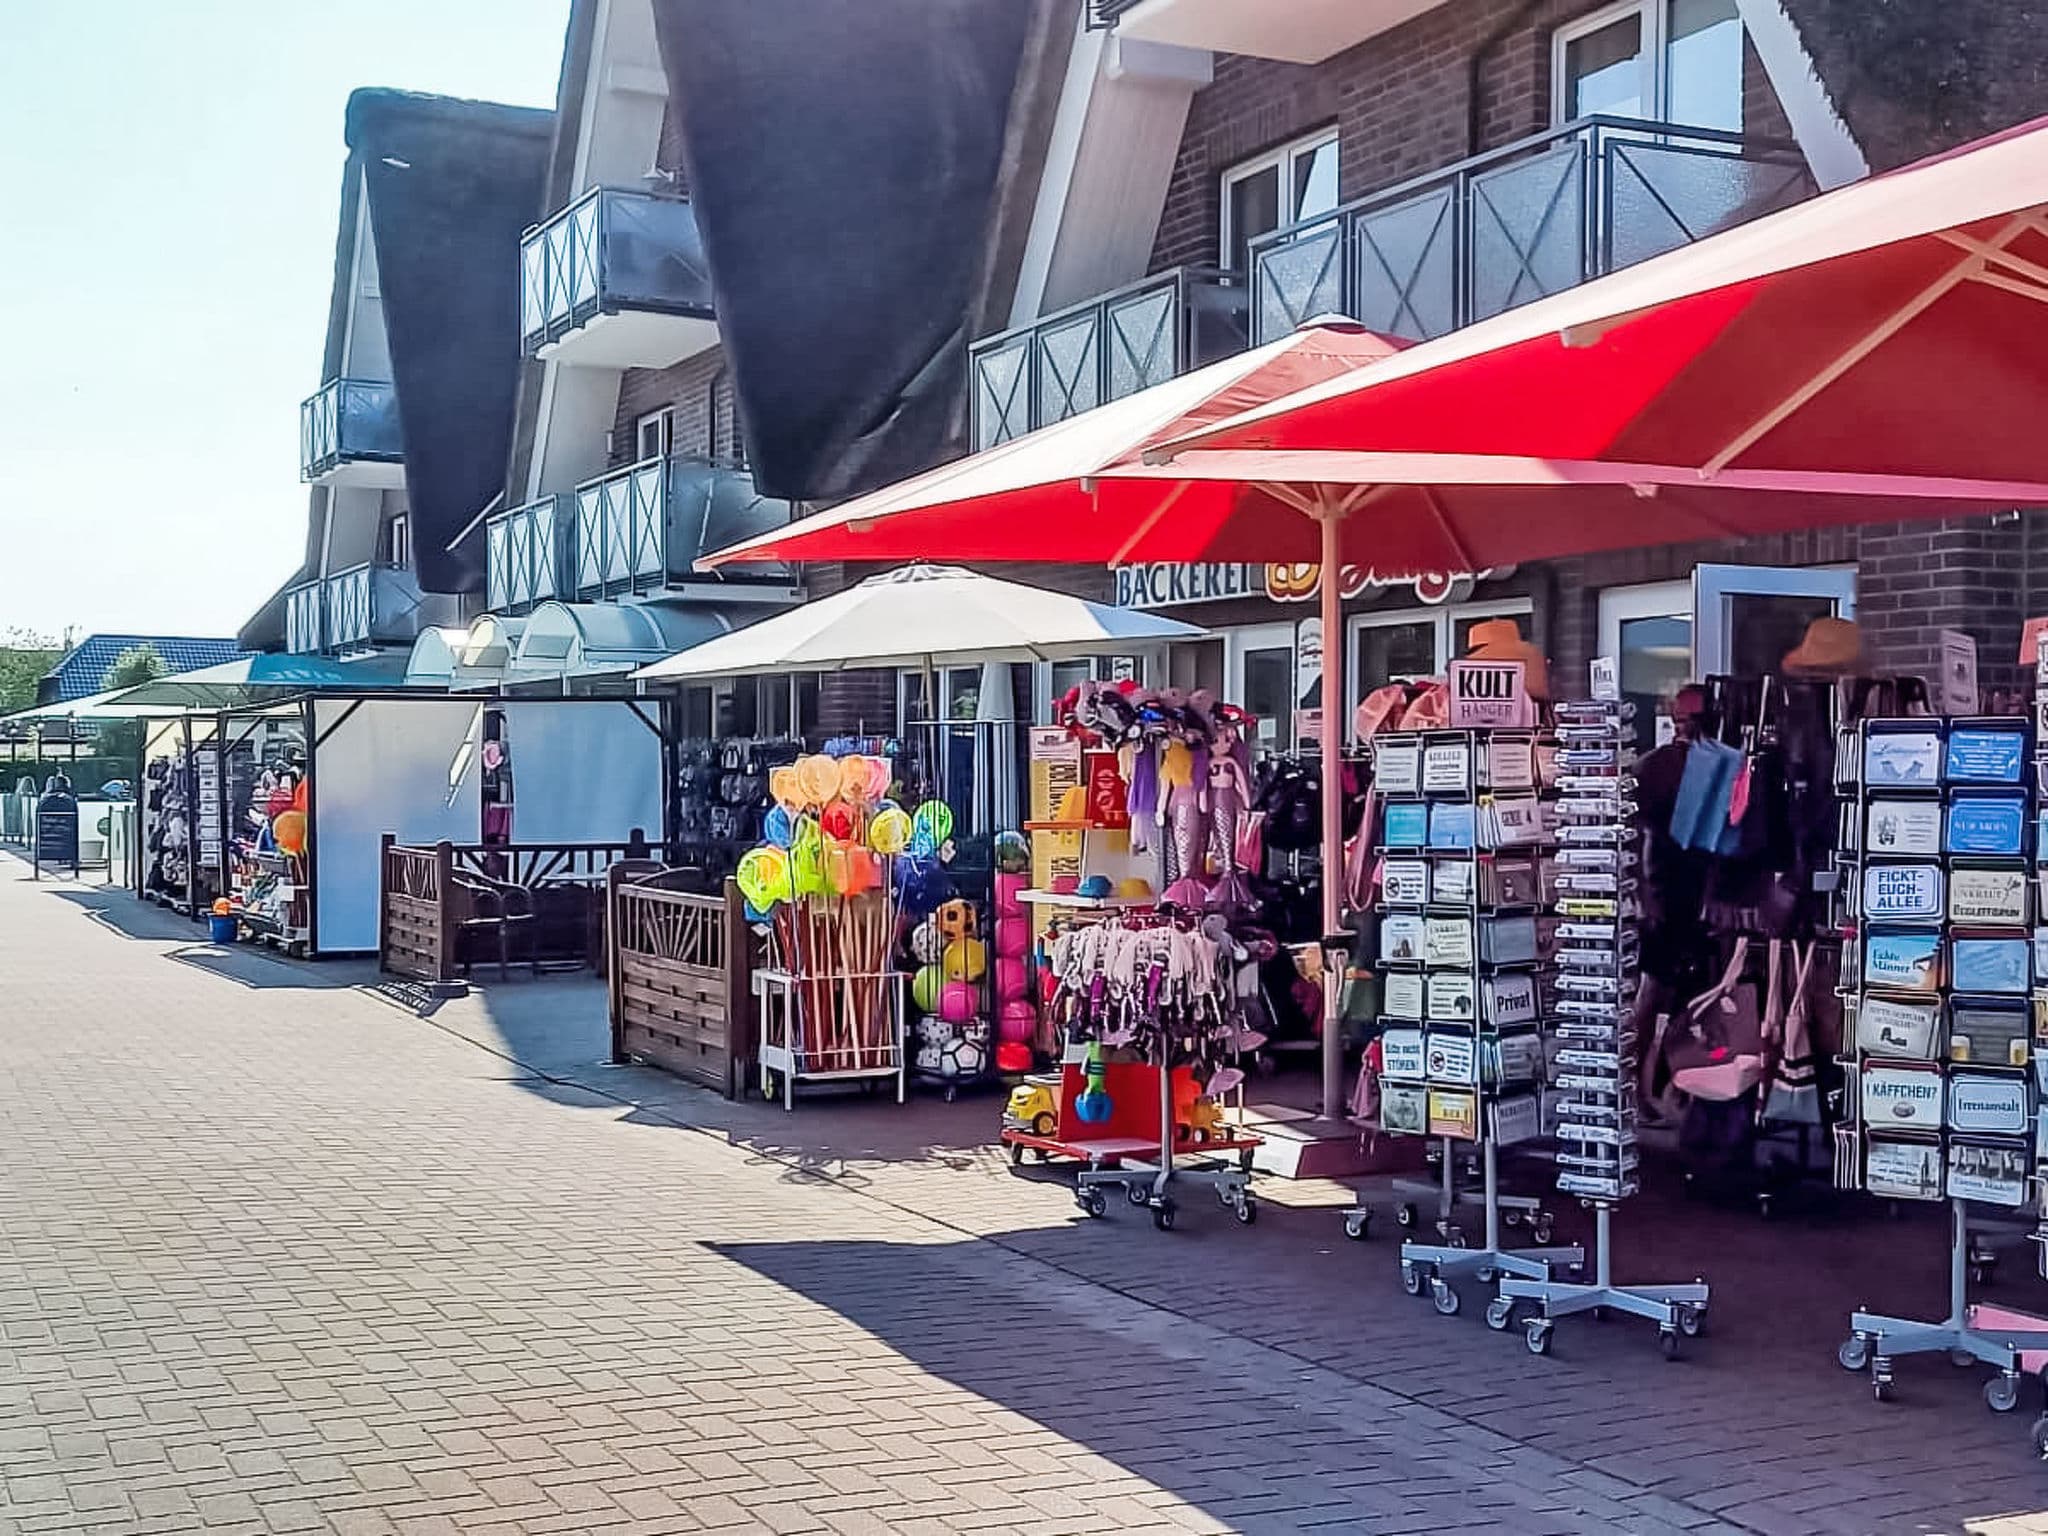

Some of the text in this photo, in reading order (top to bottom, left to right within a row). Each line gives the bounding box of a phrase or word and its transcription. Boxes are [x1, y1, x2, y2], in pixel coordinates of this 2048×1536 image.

[1458, 669, 1517, 699] KULT
[1877, 870, 1924, 882] FICKT-
[1878, 883, 1924, 895] EUCH-
[1877, 895, 1923, 908] ALLEE
